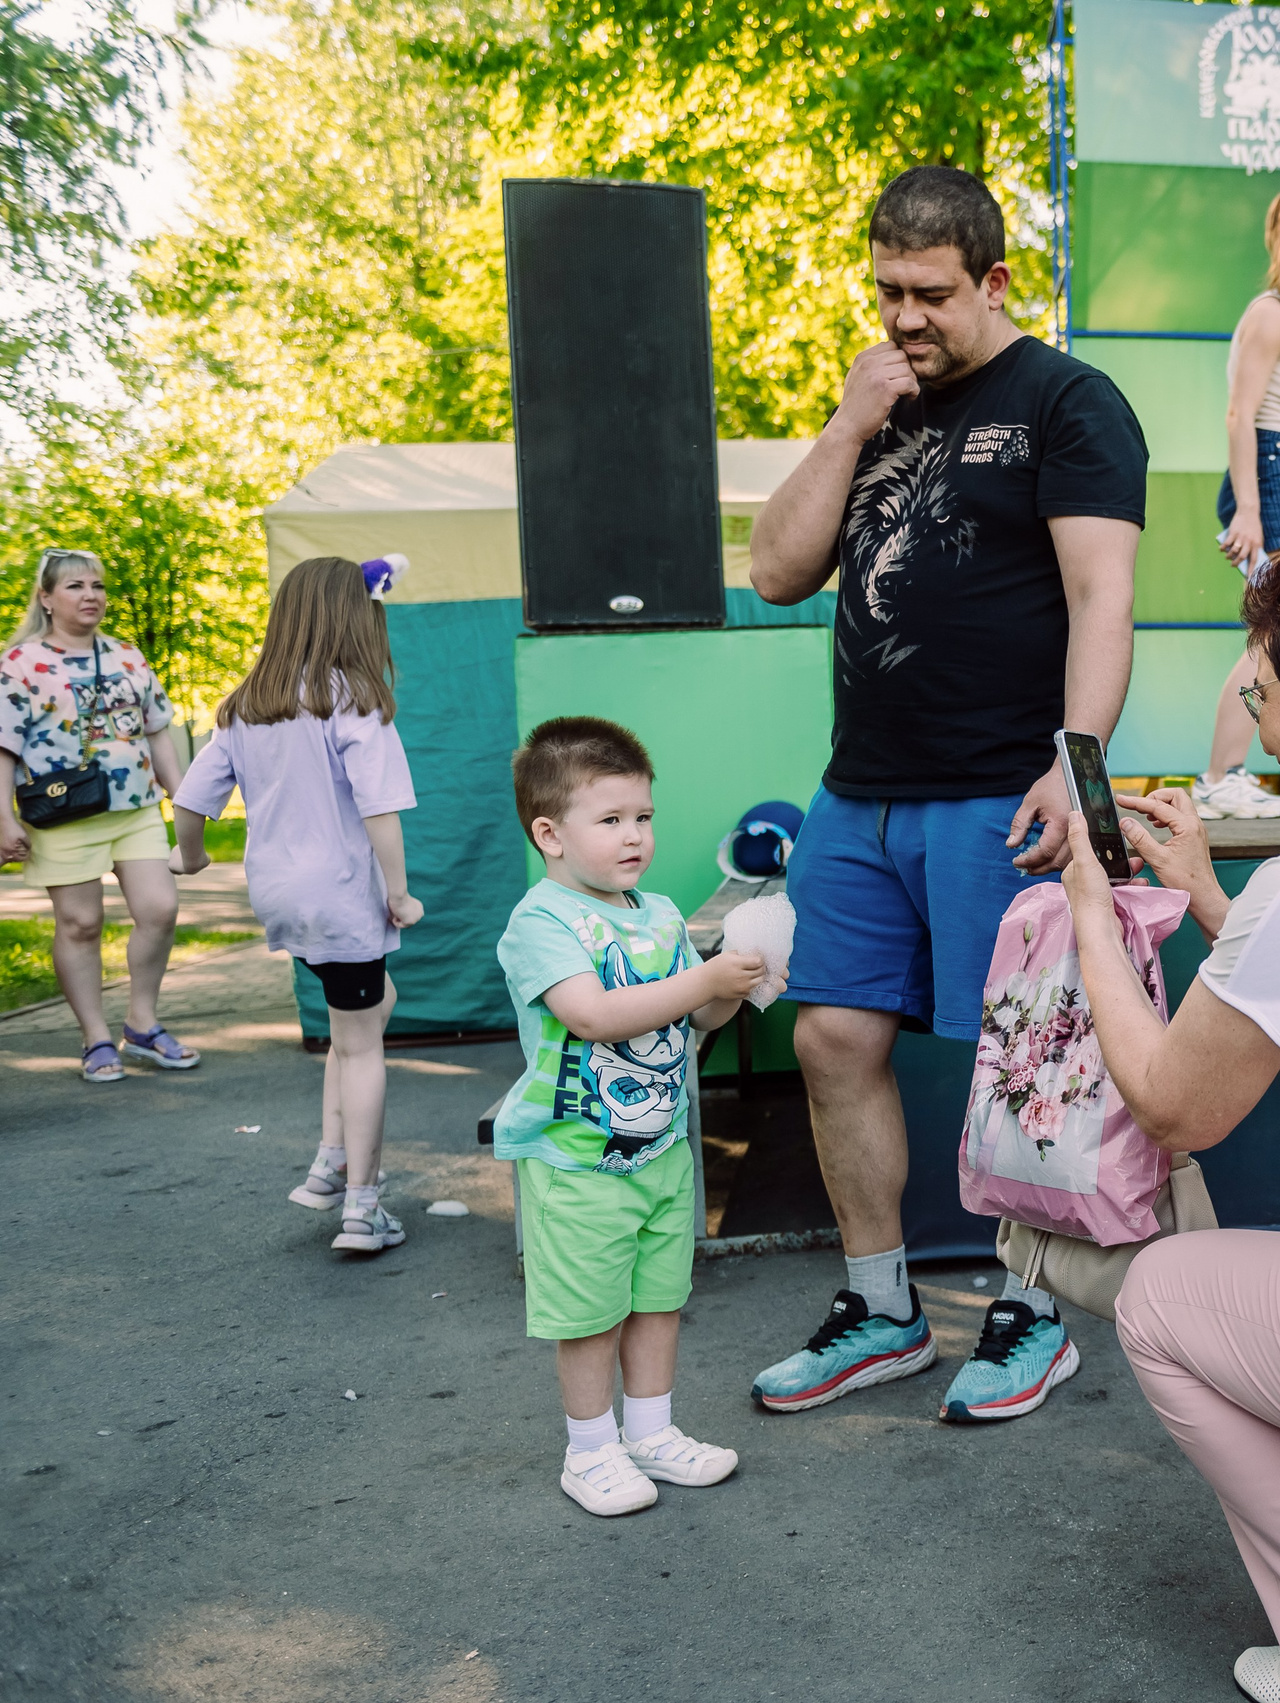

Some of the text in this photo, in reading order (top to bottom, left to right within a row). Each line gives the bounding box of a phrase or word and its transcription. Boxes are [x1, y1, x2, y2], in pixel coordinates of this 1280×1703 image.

[967, 428, 1011, 442] STRENGTH
[964, 439, 1004, 452] WITHOUT
[961, 451, 994, 463] WORDS
[992, 1311, 1015, 1322] HOKA
